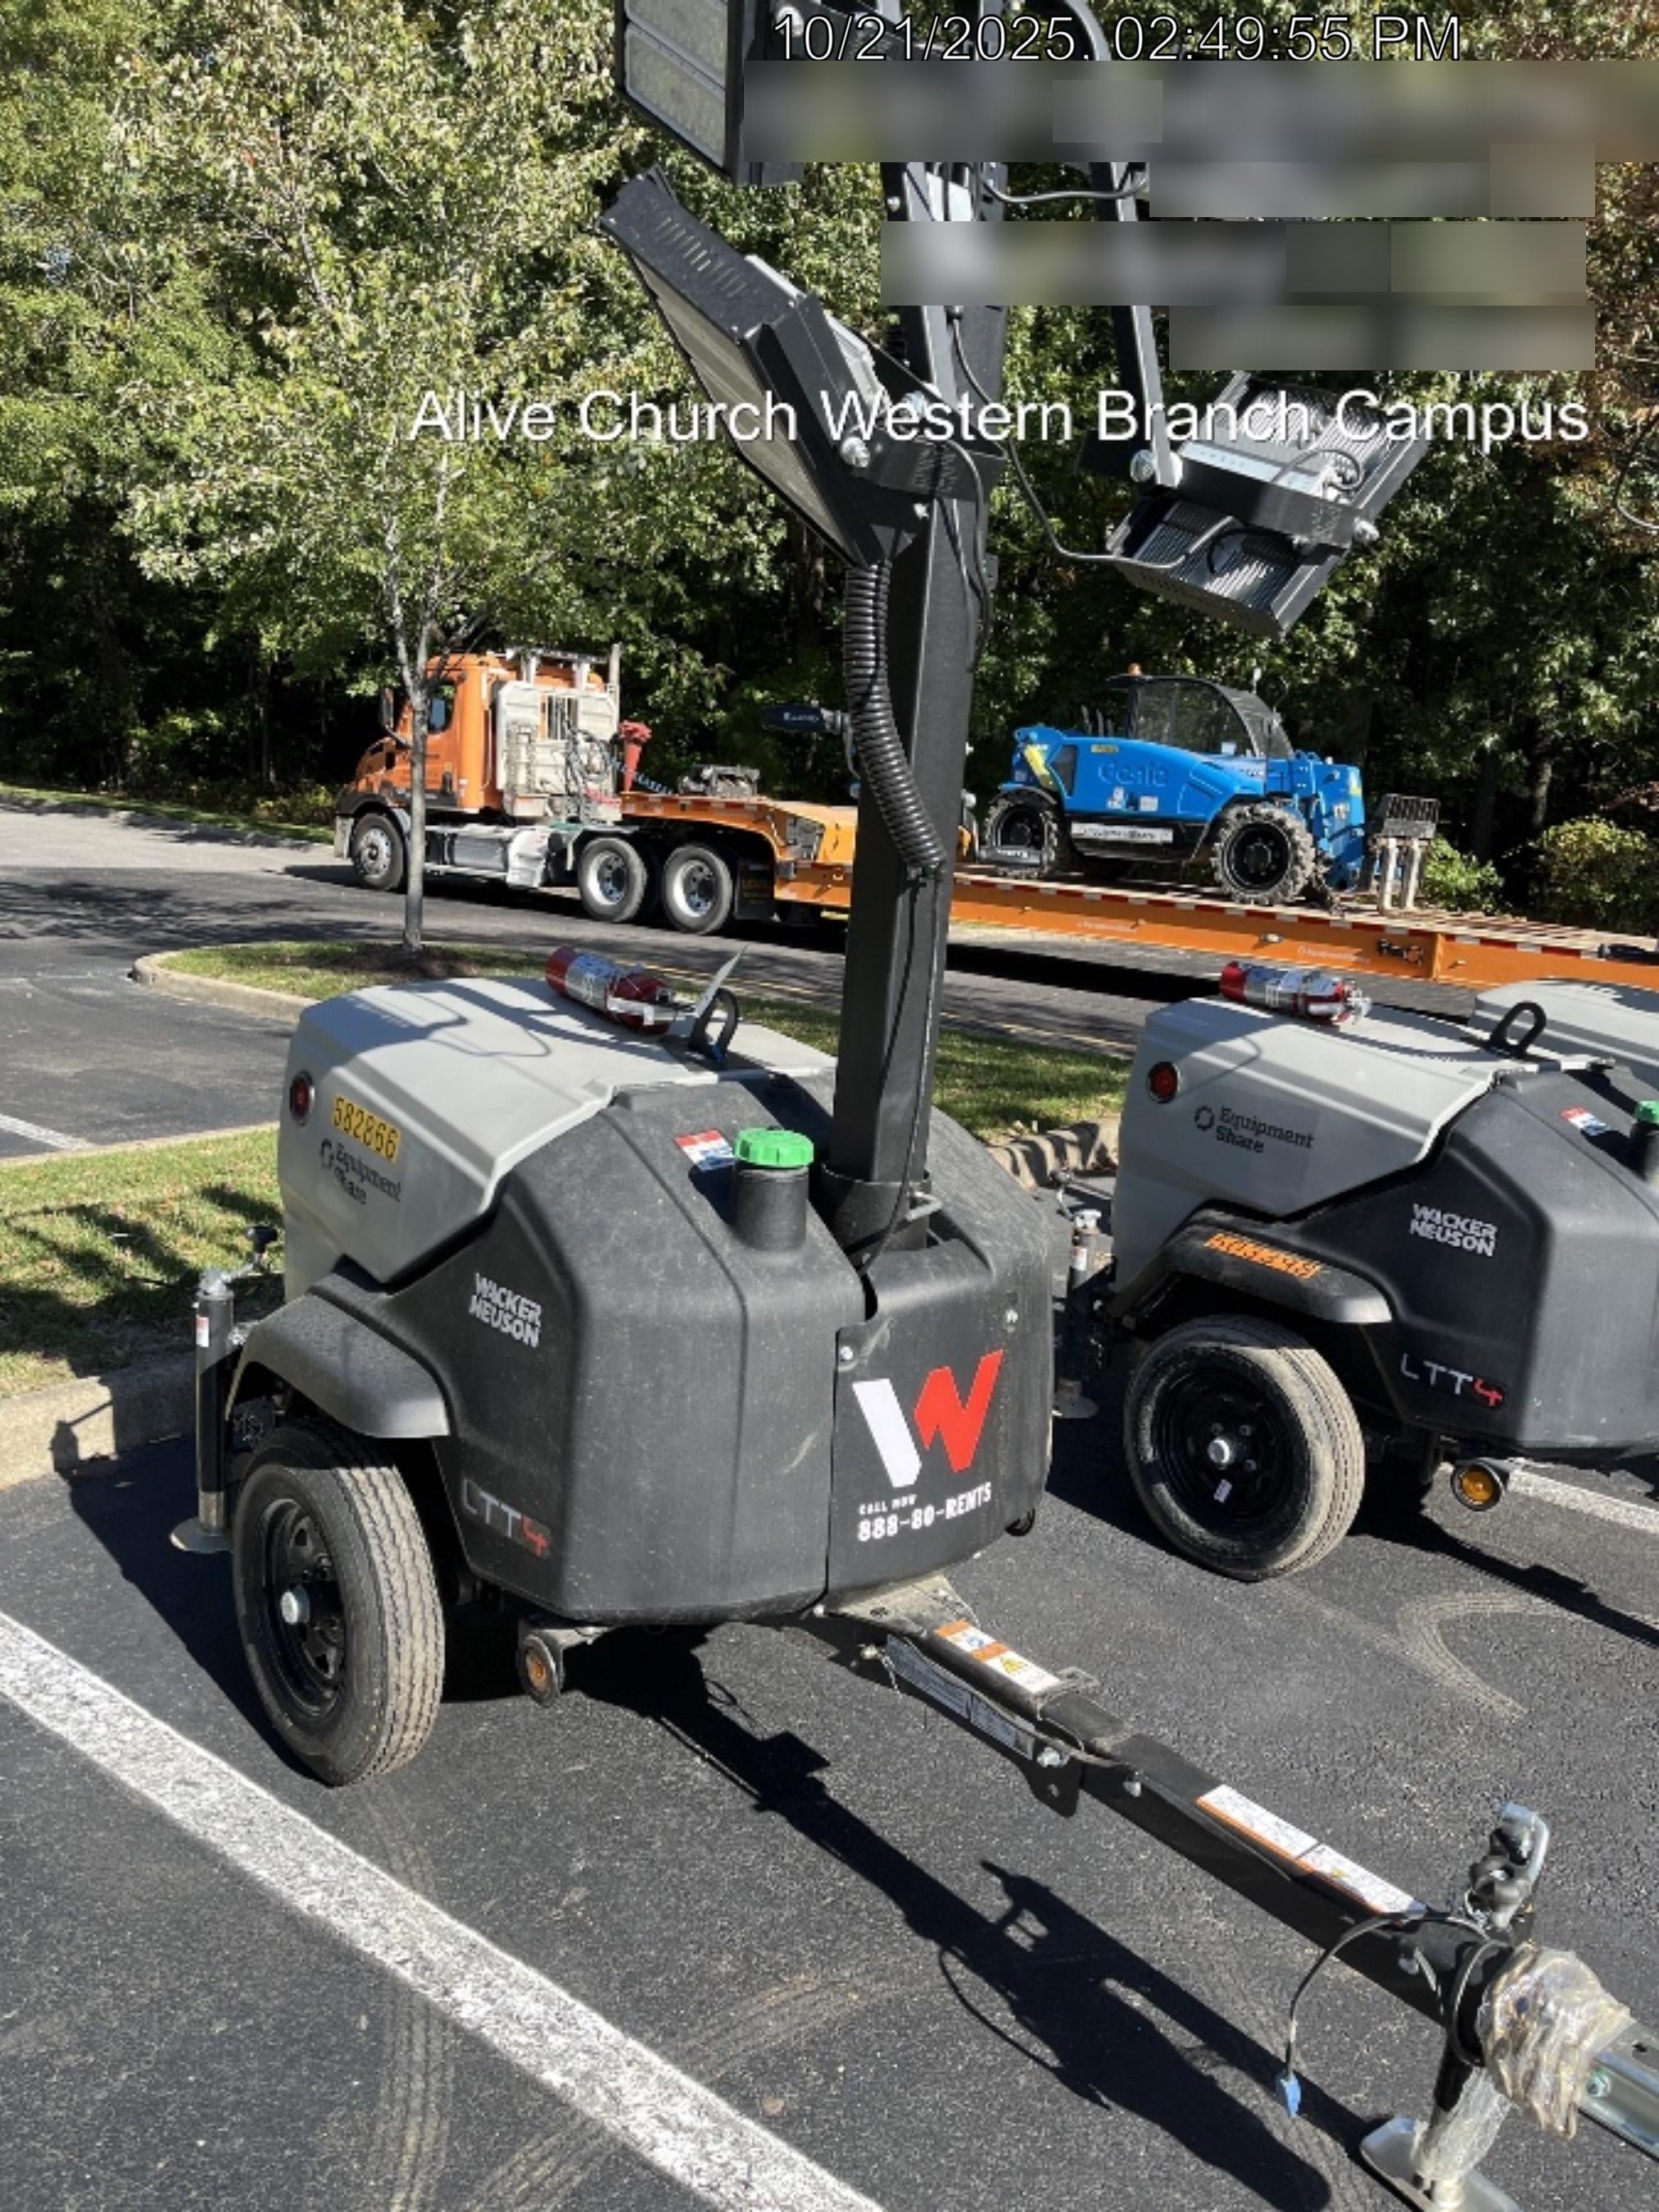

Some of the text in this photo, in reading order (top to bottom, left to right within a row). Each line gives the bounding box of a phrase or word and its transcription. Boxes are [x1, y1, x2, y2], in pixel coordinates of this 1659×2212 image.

[1216, 1125, 1265, 1154] Share
[1218, 1107, 1315, 1149] Equipment
[1409, 1219, 1496, 1257] NEUSON
[1412, 1203, 1498, 1240] WACKER
[469, 1294, 540, 1349] NEUSON
[475, 1271, 542, 1327] WACKER
[1400, 1353, 1504, 1407] LTT4
[463, 1478, 551, 1557] LTT4
[857, 1481, 992, 1543] 888-80-RENTS
